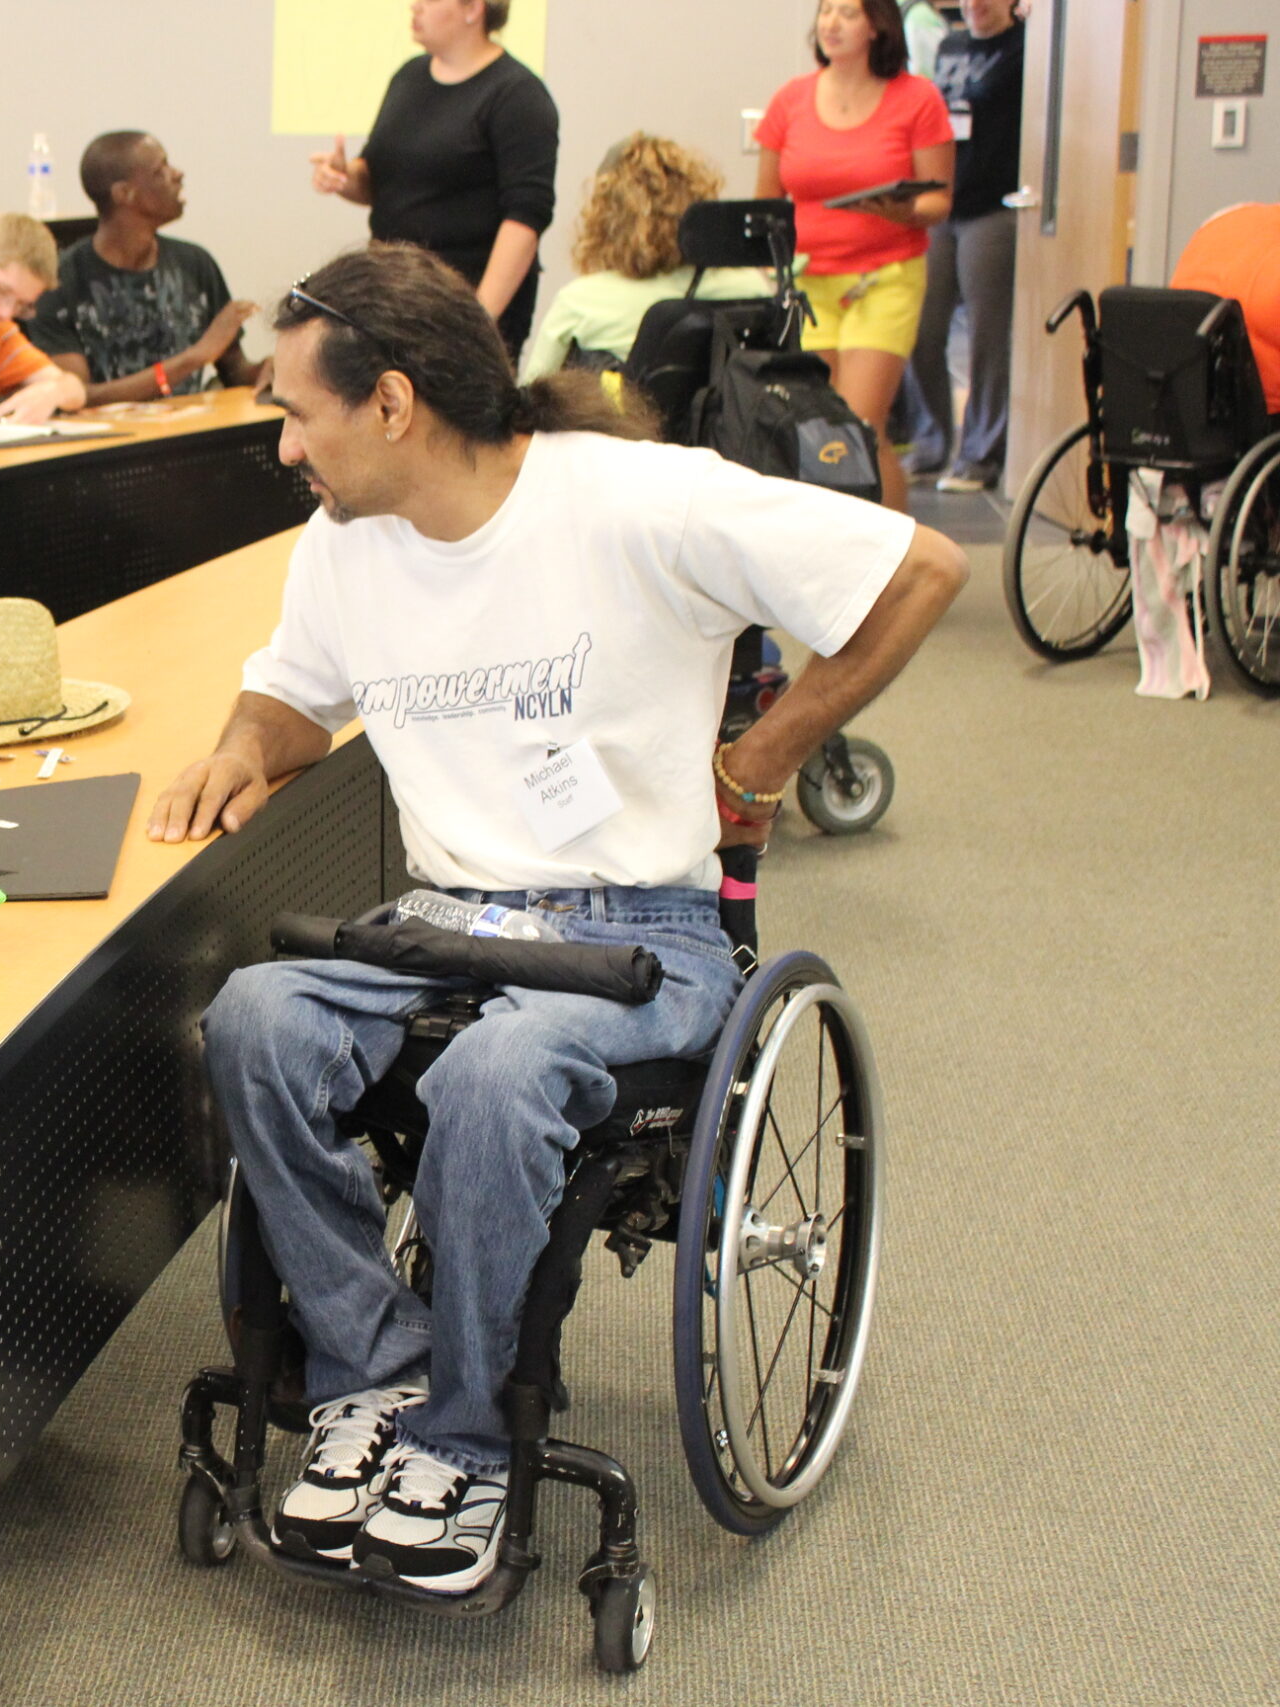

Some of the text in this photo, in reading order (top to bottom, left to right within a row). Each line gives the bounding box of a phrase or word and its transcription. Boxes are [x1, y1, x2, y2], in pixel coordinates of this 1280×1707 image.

[514, 687, 572, 721] NCYLN
[523, 752, 573, 791] Michael
[540, 775, 578, 805] Atkins
